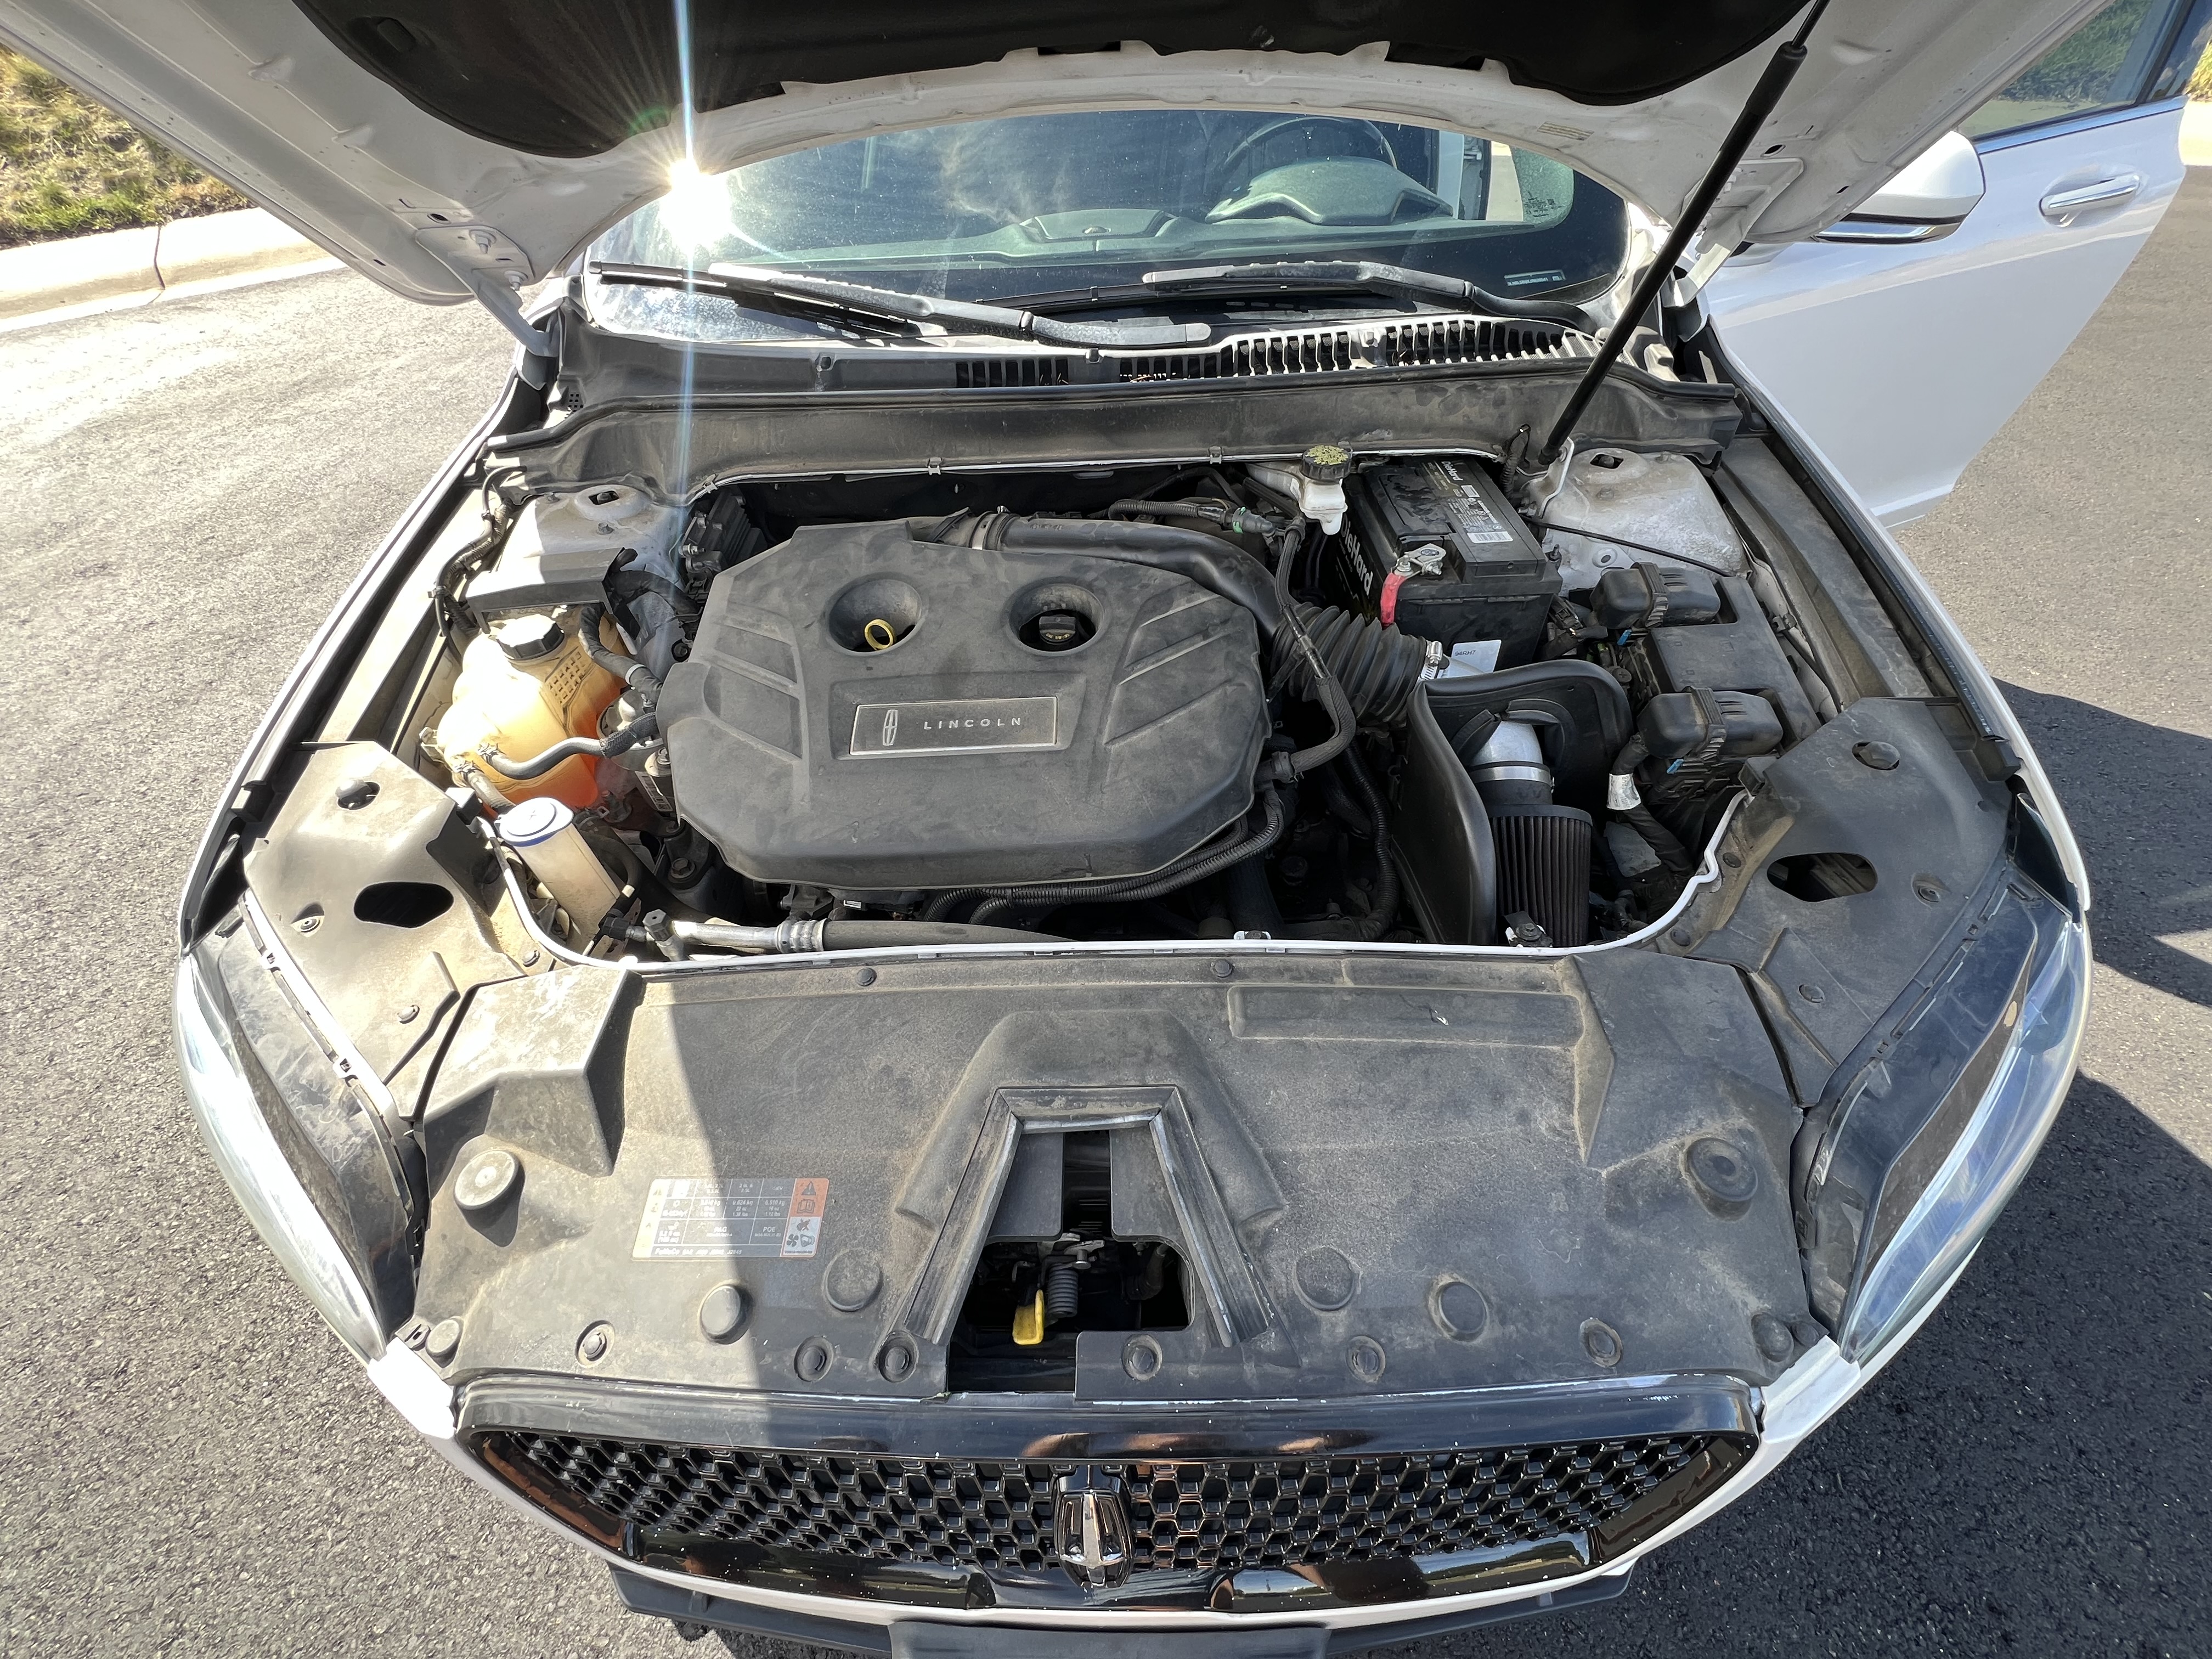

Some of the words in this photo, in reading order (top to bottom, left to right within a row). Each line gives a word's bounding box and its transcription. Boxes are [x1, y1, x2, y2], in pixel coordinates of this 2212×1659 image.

[1441, 461, 1464, 481] DieHard
[1340, 513, 1374, 596] DieHard
[923, 717, 1022, 730] LINCOLN
